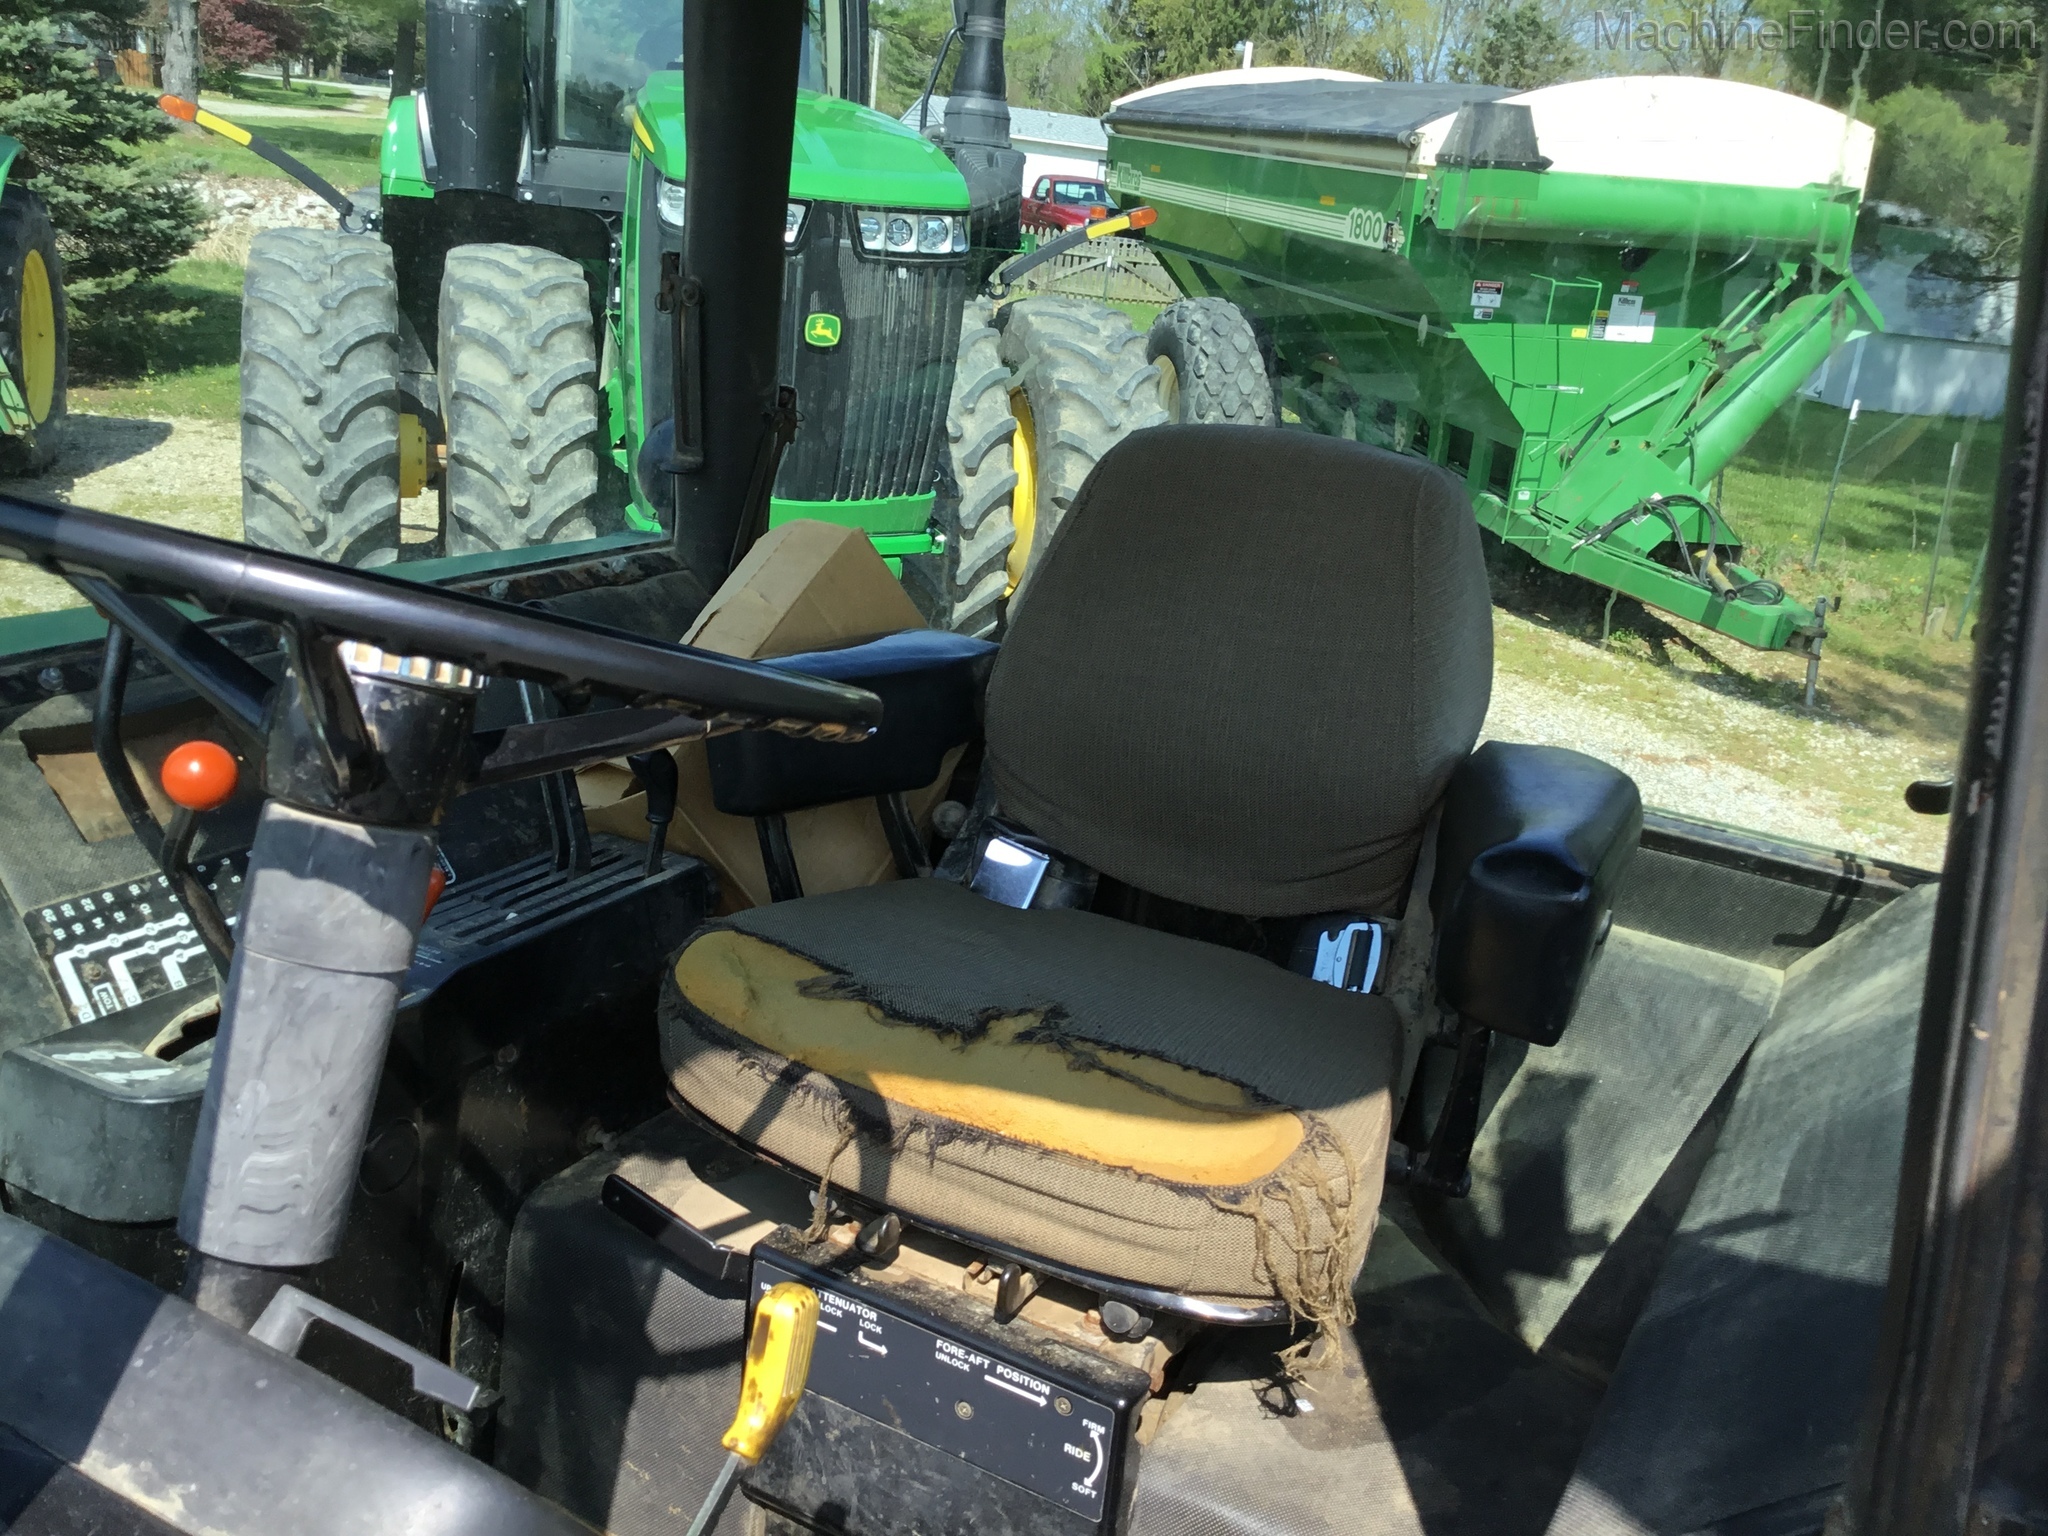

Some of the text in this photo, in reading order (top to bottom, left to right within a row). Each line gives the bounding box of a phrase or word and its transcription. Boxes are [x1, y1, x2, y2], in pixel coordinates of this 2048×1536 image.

[1349, 211, 1382, 243] 1800
[81, 897, 105, 929] 14 22
[102, 892, 126, 923] 12 19
[128, 884, 152, 915] 10 16
[42, 908, 67, 941] 18 29
[60, 903, 85, 935] 16 25
[99, 991, 114, 1010] TOW
[820, 1302, 843, 1318] LOCK
[859, 1318, 883, 1335] LOCK
[935, 1351, 971, 1373] UNLOCK
[936, 1339, 1051, 1396] FORE-AFT POSITION
[1082, 1418, 1106, 1435] FIRM
[1063, 1442, 1092, 1463] RIDE
[1071, 1481, 1098, 1499] SOFT
